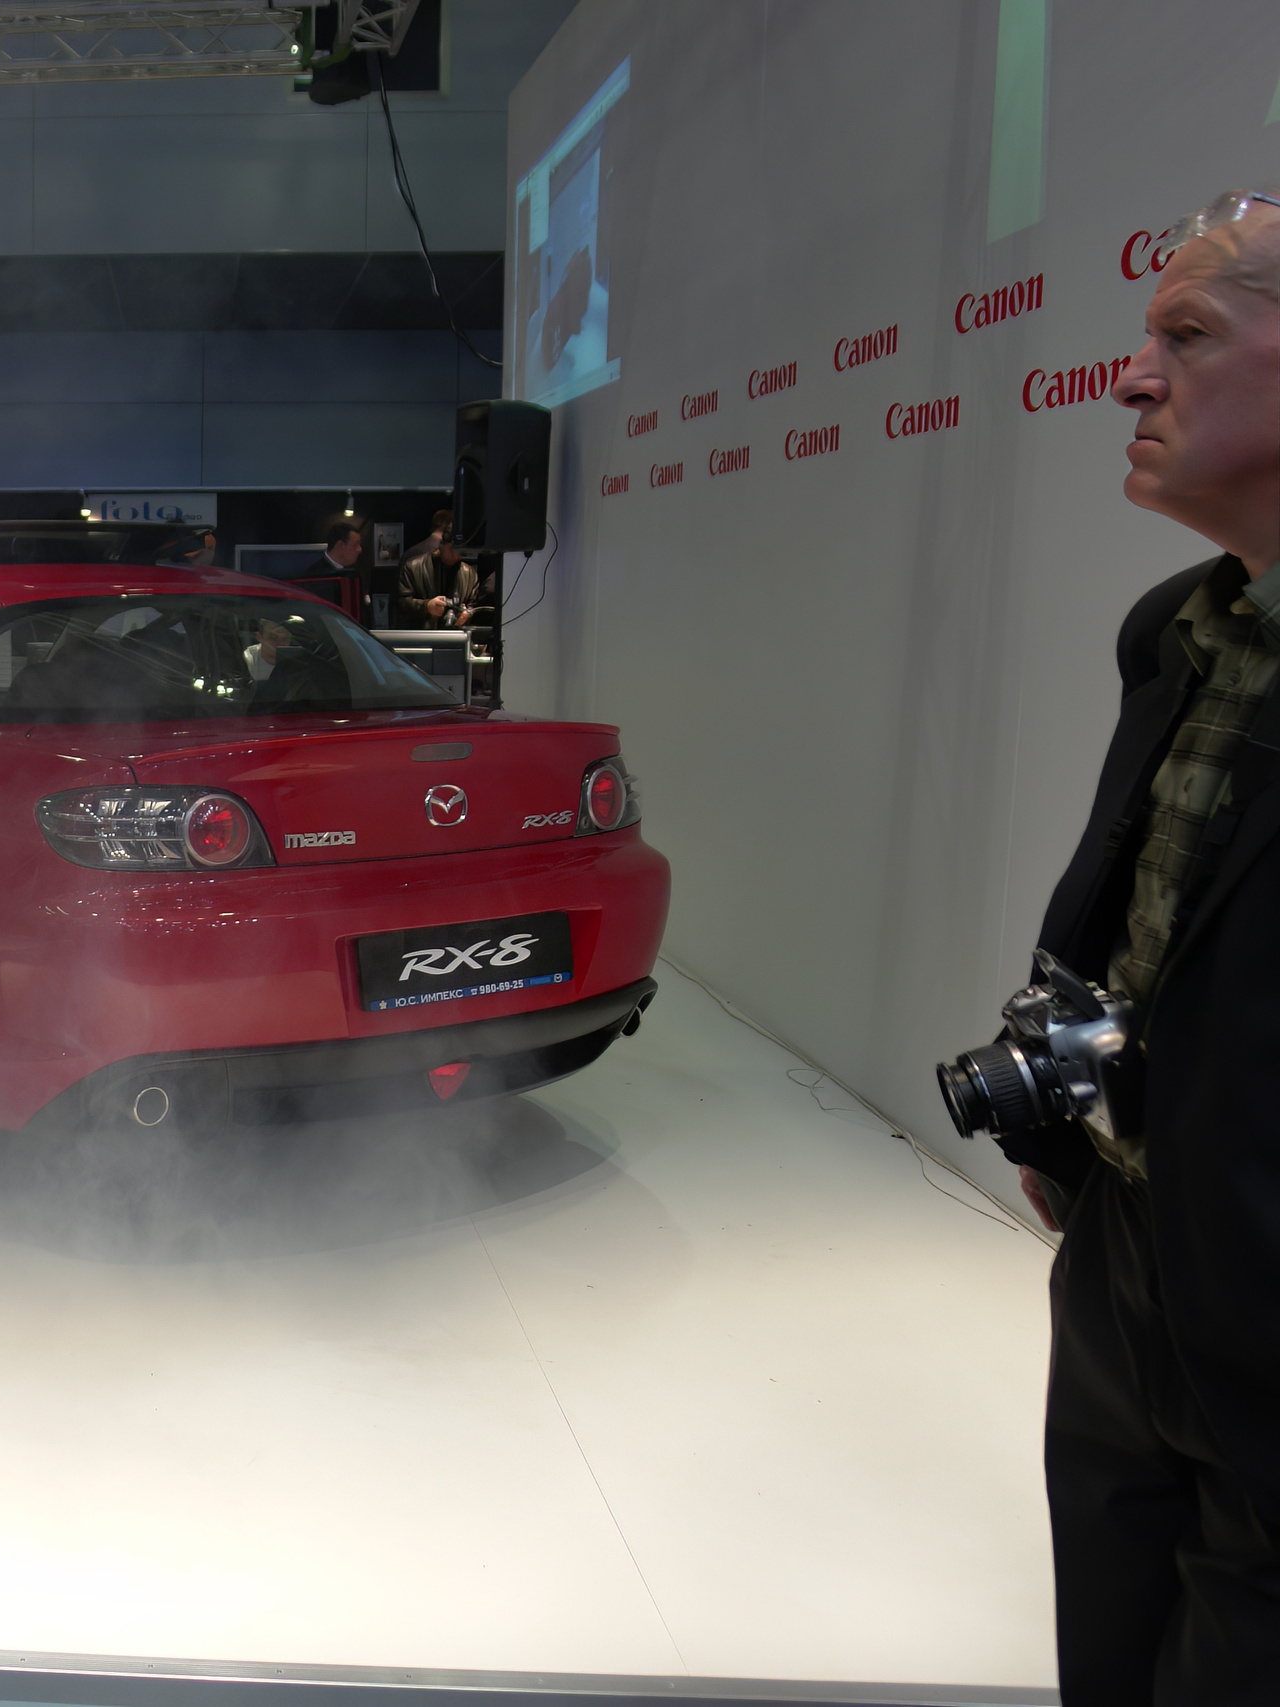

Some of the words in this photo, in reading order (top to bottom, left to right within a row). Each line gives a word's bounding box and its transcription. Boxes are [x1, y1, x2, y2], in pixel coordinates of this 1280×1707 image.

[954, 272, 1044, 335] Canon
[833, 323, 899, 373] Canon
[747, 360, 798, 400] Canon
[680, 389, 719, 421] Canon
[884, 394, 961, 440] Canon
[627, 408, 659, 438] Canon
[784, 423, 841, 461] Canon
[650, 461, 683, 488] Canon
[709, 444, 750, 477] Canon
[601, 473, 629, 497] Canon
[521, 810, 575, 829] RX-8
[284, 830, 356, 849] mazda
[398, 933, 540, 982] RX-8
[394, 996, 419, 1007] Ю.С.
[420, 989, 464, 1004] ИМПЕКС
[479, 979, 524, 994] 980-69-25
